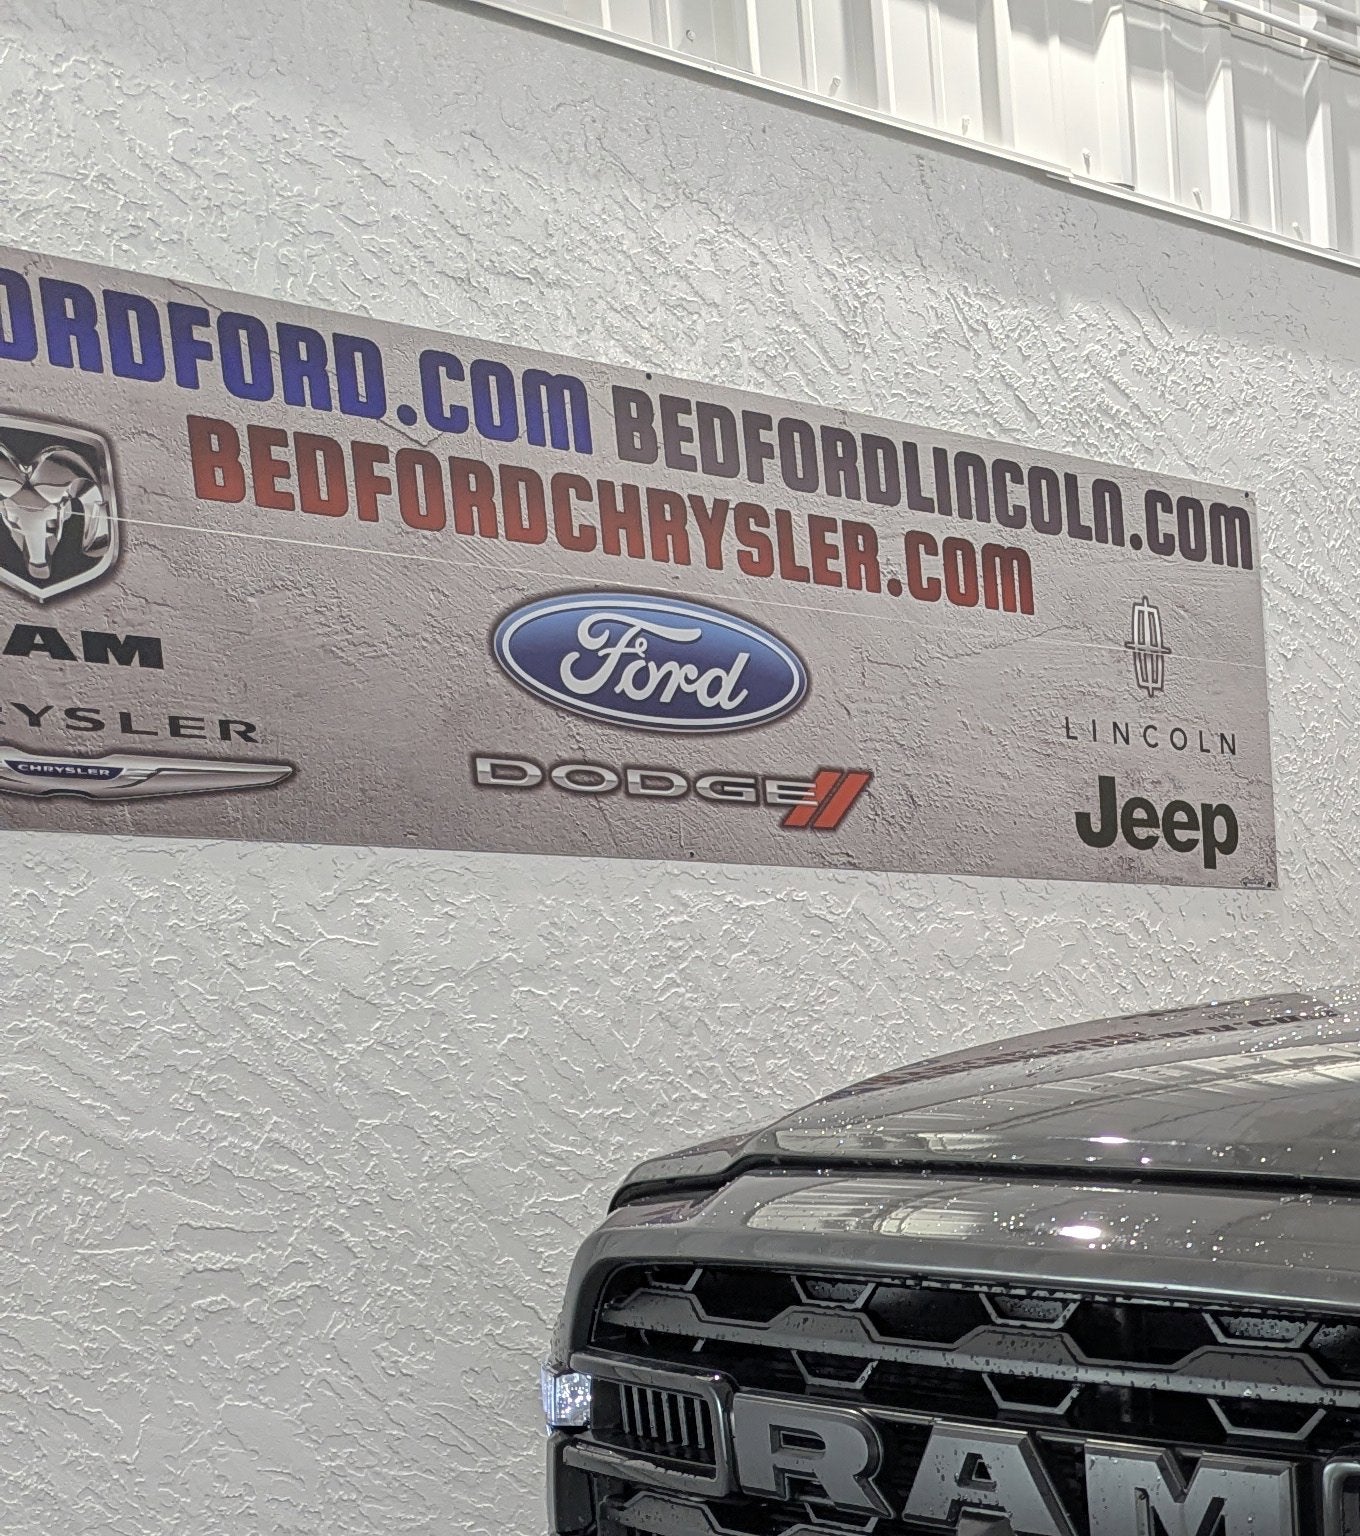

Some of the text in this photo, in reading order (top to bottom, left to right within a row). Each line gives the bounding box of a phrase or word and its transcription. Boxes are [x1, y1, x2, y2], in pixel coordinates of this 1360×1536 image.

[612, 385, 1254, 571] BEDFORDLINCOLN.COM
[186, 414, 1035, 616] BEDFORDCHRYSLER.COM
[560, 613, 749, 710] Ford
[0, 702, 259, 744] YSLER
[1064, 716, 1237, 756] LINCOLN
[17, 763, 111, 777] CHRYSLER
[475, 757, 820, 807] DODGE
[1074, 774, 1240, 869] Jeep
